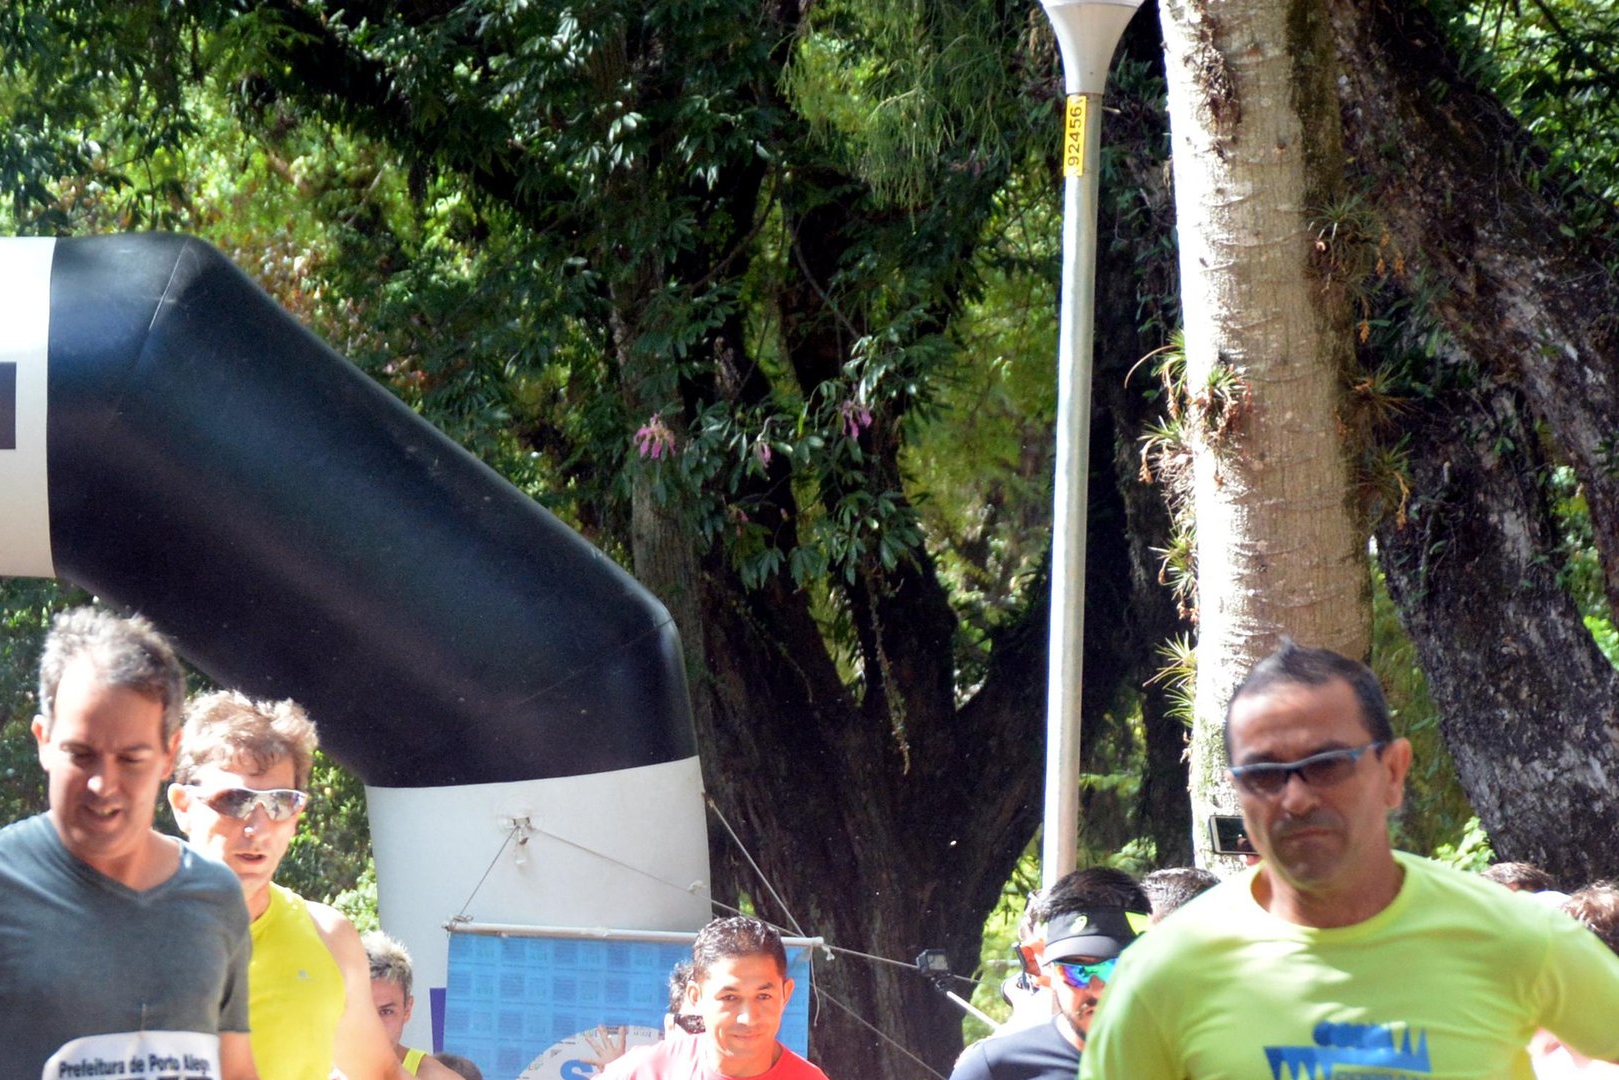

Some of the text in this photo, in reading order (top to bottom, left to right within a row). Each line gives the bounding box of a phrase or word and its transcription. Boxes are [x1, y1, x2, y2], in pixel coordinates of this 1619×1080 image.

[1068, 106, 1082, 166] 92456
[59, 1058, 125, 1078] Prefeitura
[129, 1056, 145, 1073] de
[149, 1053, 179, 1072] Porto
